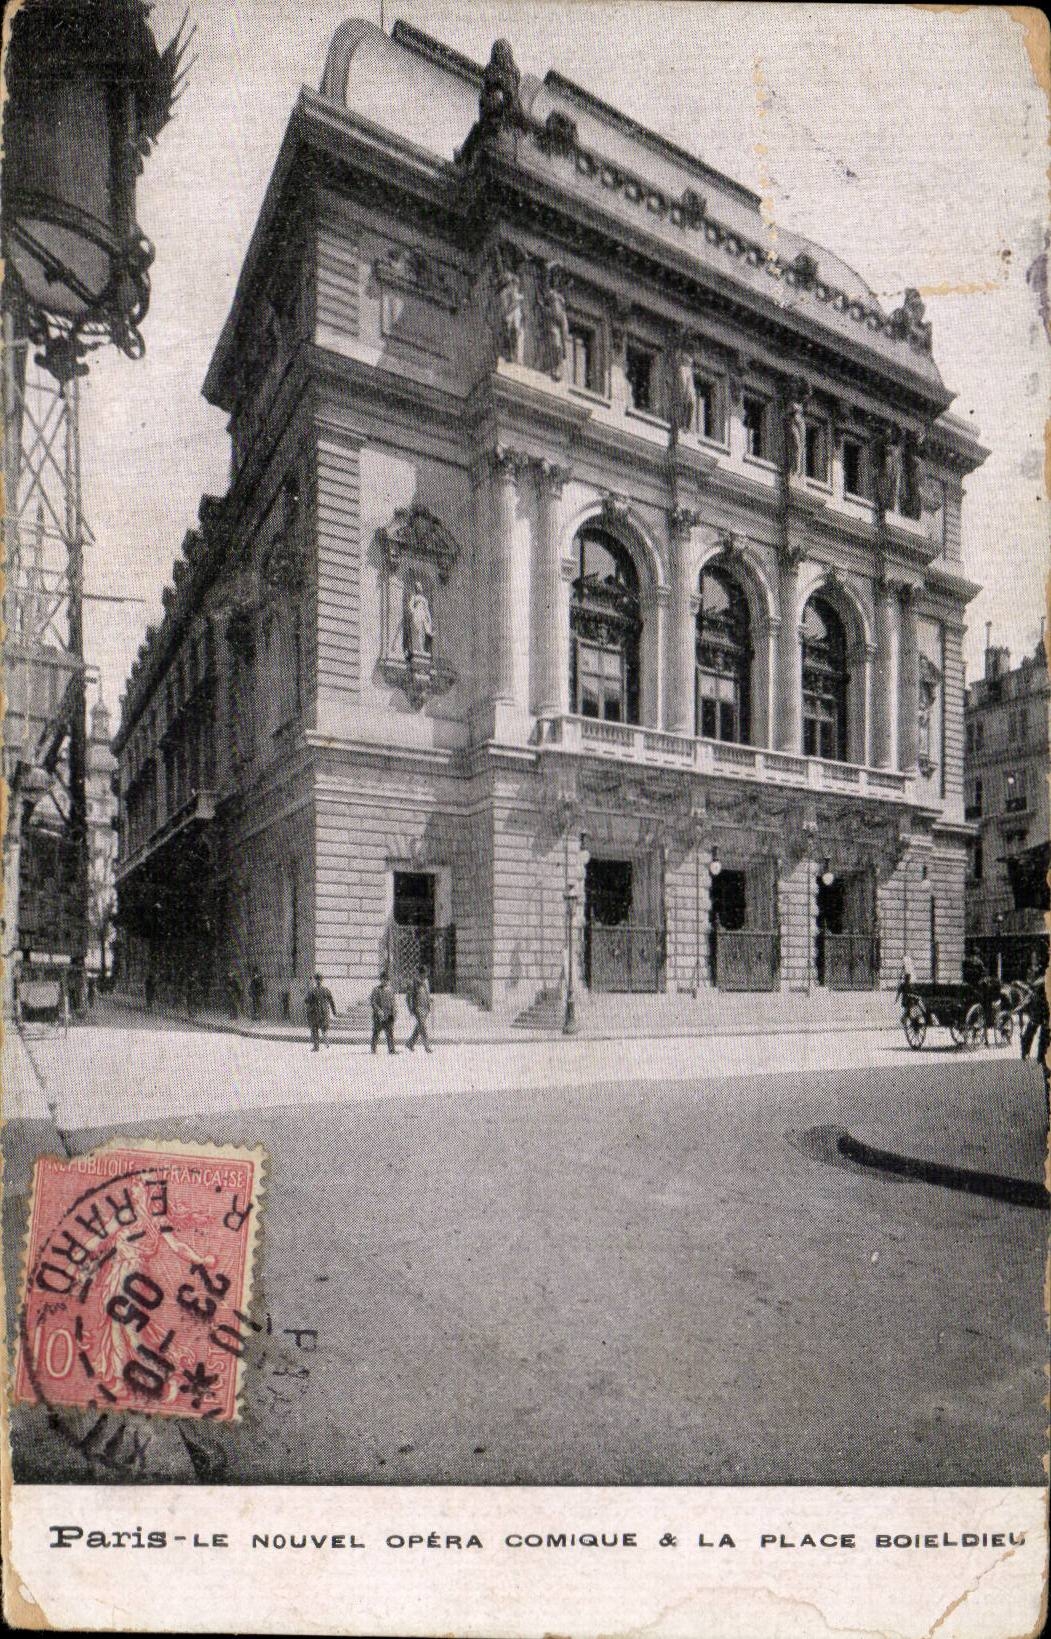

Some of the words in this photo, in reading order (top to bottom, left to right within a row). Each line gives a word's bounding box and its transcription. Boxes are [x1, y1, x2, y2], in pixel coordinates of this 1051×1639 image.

[35, 1179, 168, 1294] ERARD
[106, 1271, 165, 1333] 05
[176, 1263, 231, 1322] 23
